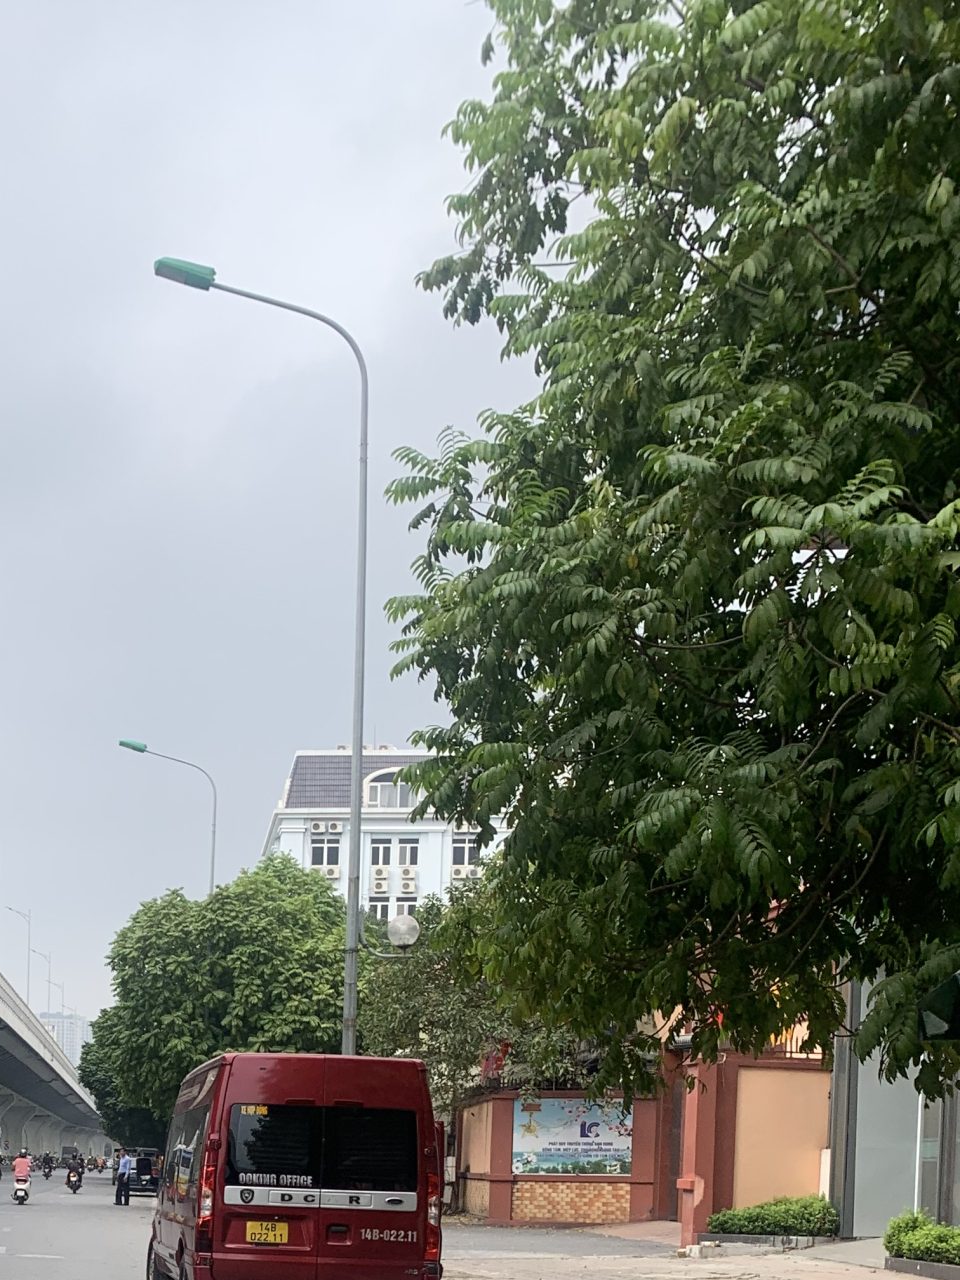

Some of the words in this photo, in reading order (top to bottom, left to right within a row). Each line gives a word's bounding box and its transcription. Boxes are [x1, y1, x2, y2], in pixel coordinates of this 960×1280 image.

[280, 1174, 313, 1187] OFFICE
[260, 1222, 277, 1232] 14B
[250, 1232, 283, 1242] 022.11
[360, 1228, 417, 1242] 14B-022.11
